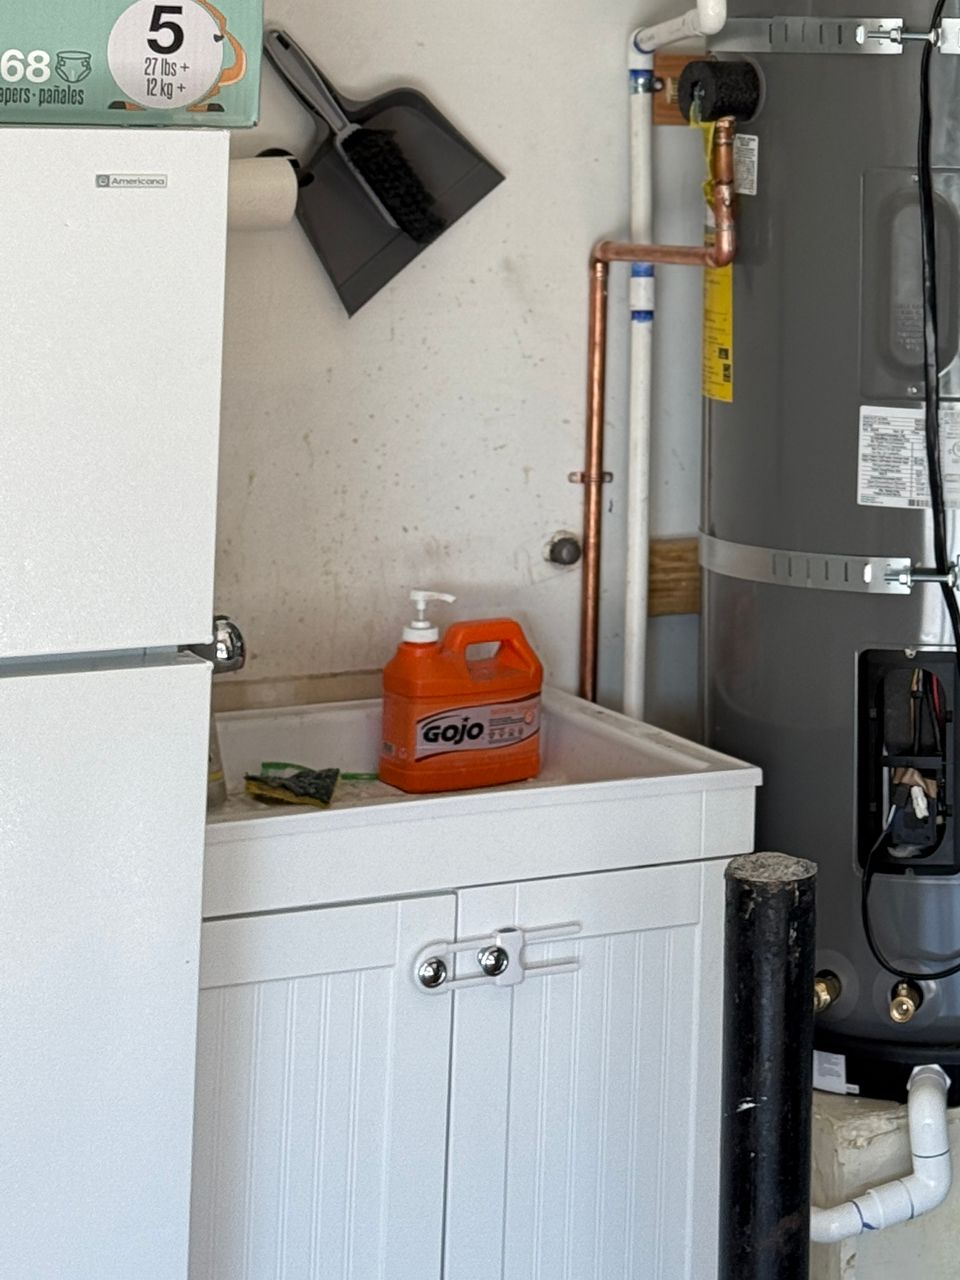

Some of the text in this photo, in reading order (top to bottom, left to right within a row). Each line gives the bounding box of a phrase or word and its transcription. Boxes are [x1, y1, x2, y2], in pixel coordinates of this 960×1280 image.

[147, 5, 184, 55] 5
[1, 49, 51, 83] 68
[144, 58, 158, 76] 27
[160, 58, 177, 76] lbs
[39, 85, 84, 107] pañales
[146, 78, 158, 96] 12
[160, 78, 173, 99] kg
[111, 177, 165, 185] Americana
[423, 716, 484, 745] GOJO
